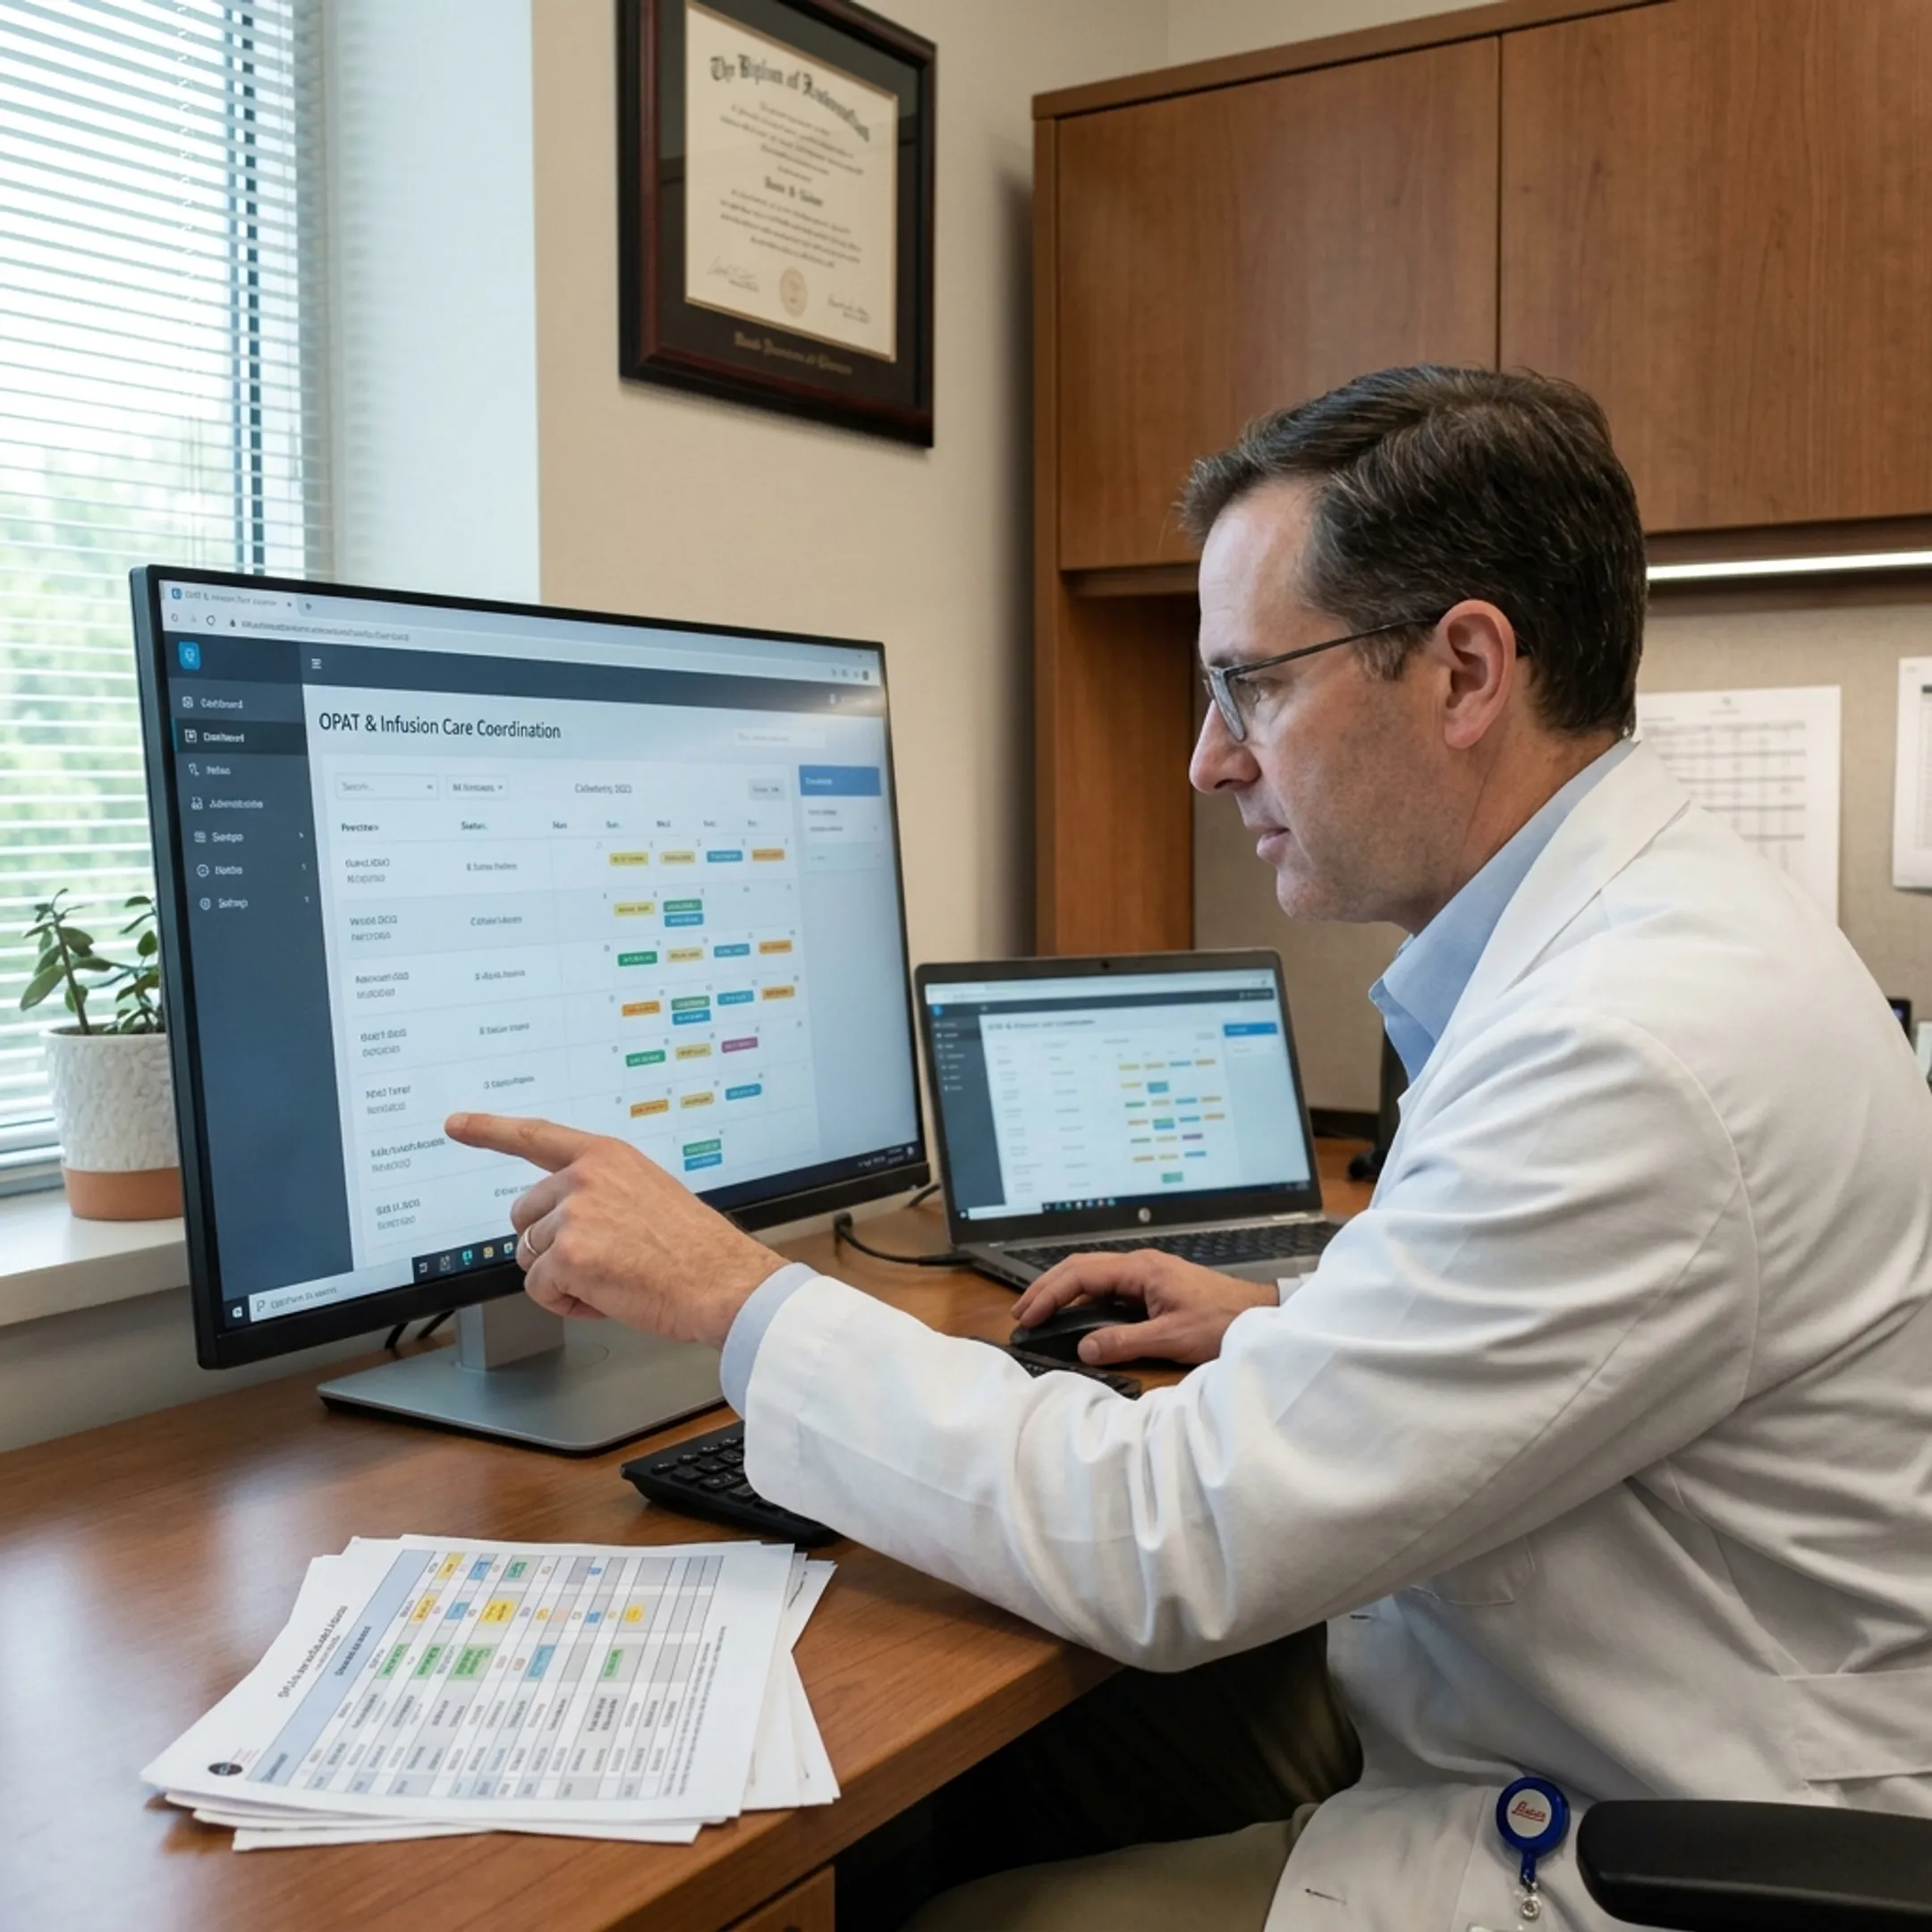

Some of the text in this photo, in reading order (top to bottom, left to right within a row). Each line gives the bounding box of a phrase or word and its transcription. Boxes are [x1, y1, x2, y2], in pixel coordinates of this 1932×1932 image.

[318, 712, 360, 731] OPAT
[365, 714, 377, 732] &
[380, 715, 439, 733] Infusion
[442, 718, 473, 735] Care
